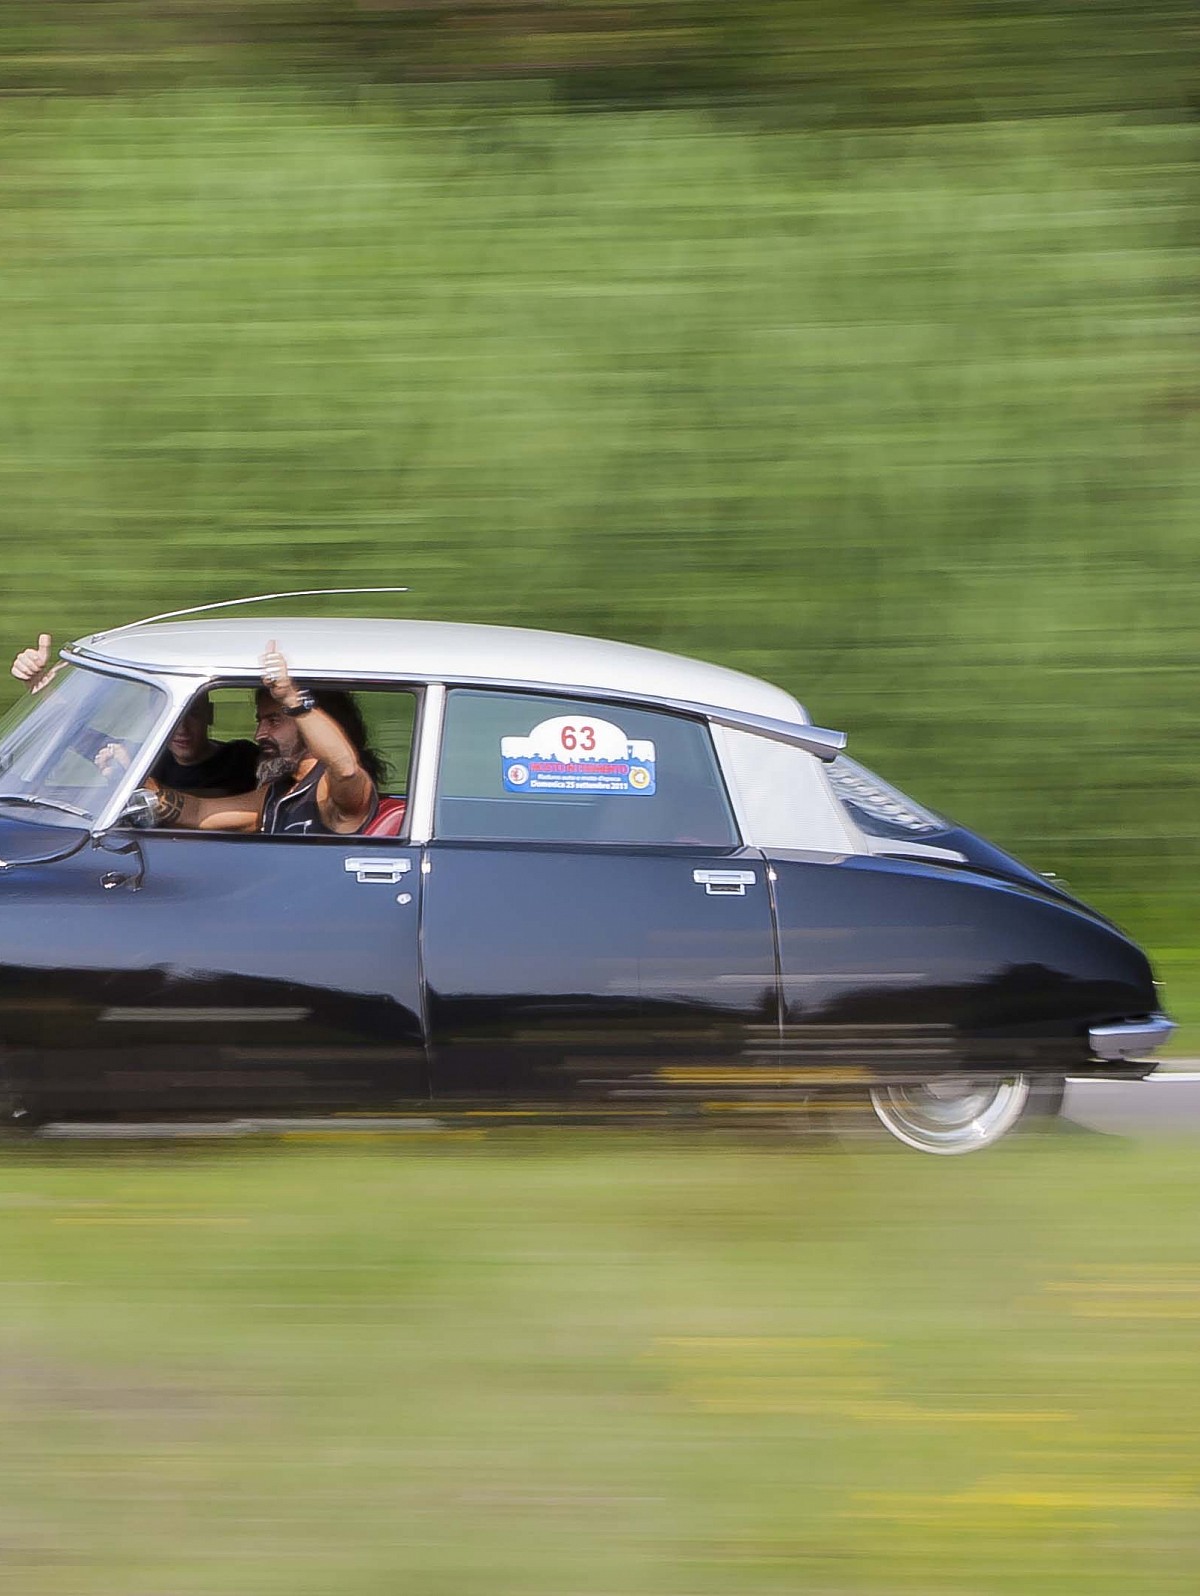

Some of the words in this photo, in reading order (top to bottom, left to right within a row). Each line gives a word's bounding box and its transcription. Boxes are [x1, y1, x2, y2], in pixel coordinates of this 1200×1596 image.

[560, 726, 596, 751] 63
[530, 780, 564, 788] Domenica
[576, 781, 609, 790] settembre
